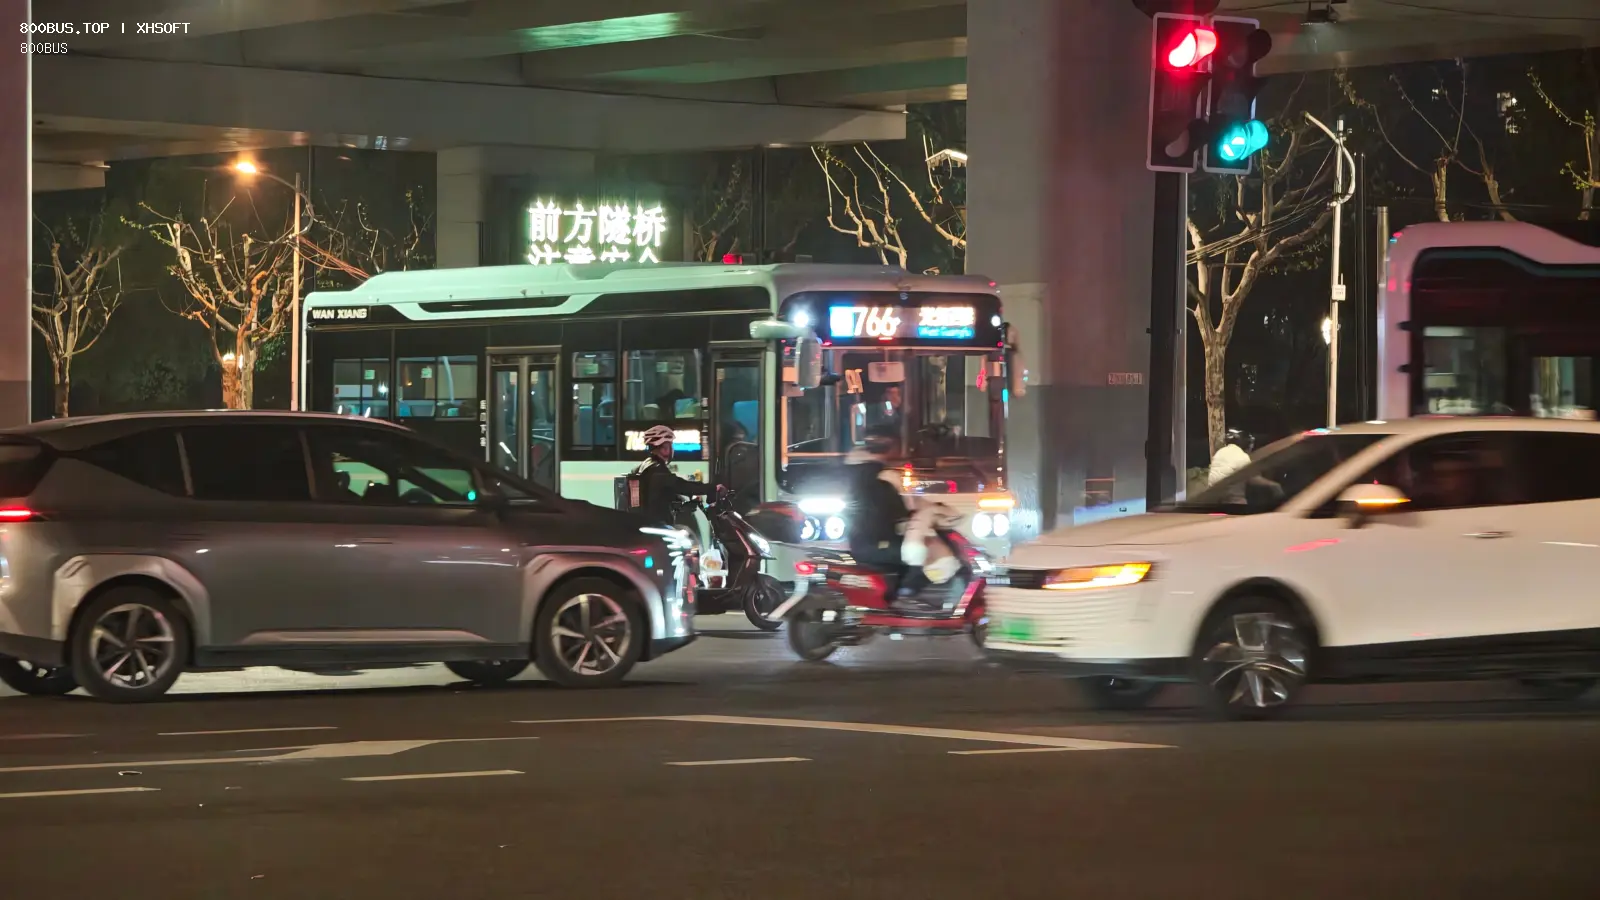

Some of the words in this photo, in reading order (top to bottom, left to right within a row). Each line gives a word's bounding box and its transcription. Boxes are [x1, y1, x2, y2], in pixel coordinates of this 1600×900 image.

[528, 200, 666, 247] 前方隧桥
[312, 309, 335, 319] WAN
[337, 308, 368, 319] XIANG
[853, 306, 899, 337] 766
